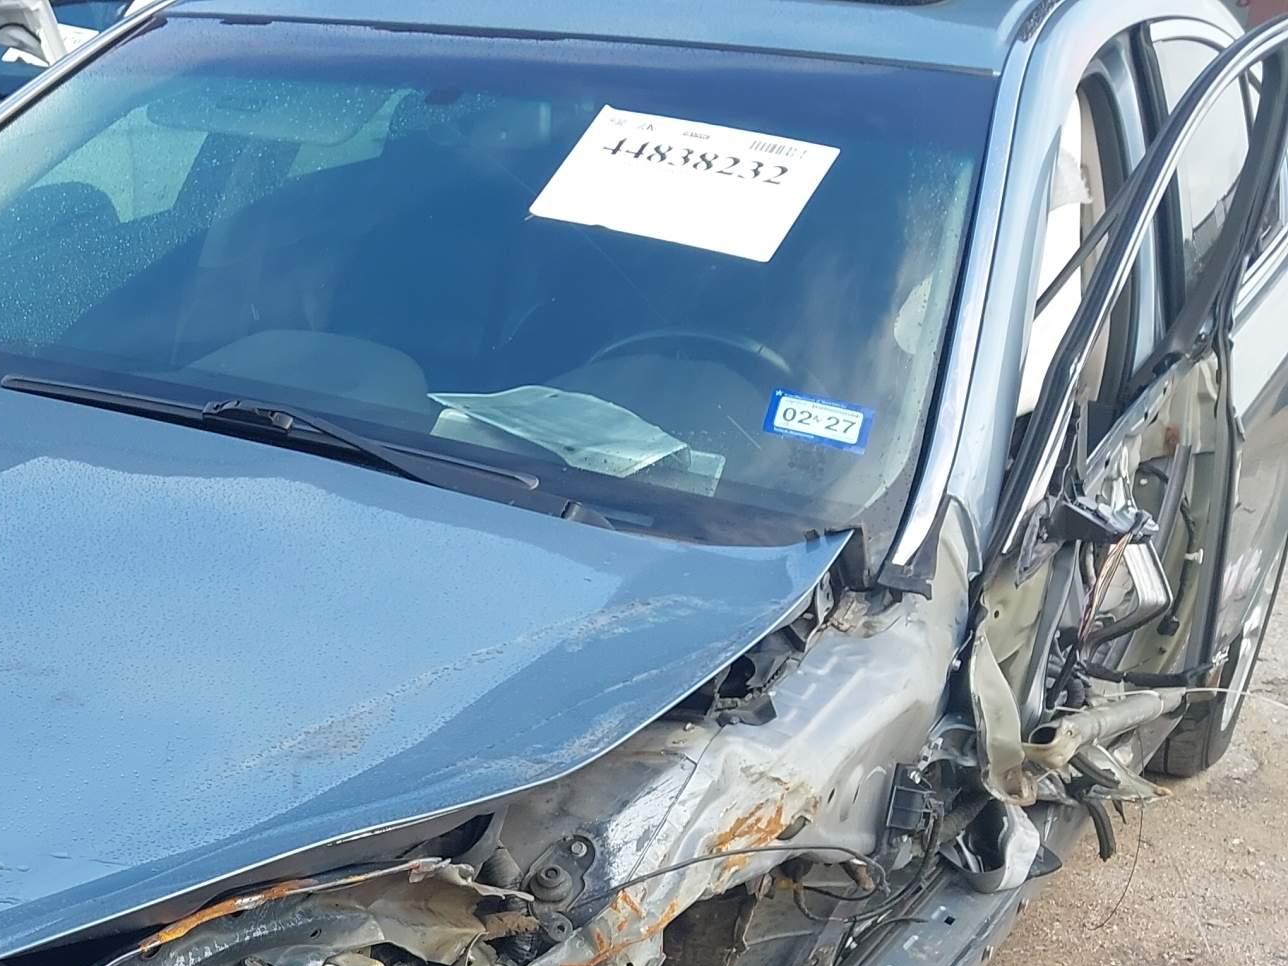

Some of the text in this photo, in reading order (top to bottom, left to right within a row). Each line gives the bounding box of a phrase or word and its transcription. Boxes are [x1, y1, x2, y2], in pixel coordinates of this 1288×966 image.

[602, 137, 789, 185] 44838232
[782, 407, 813, 426] 02
[824, 415, 857, 434] 27
